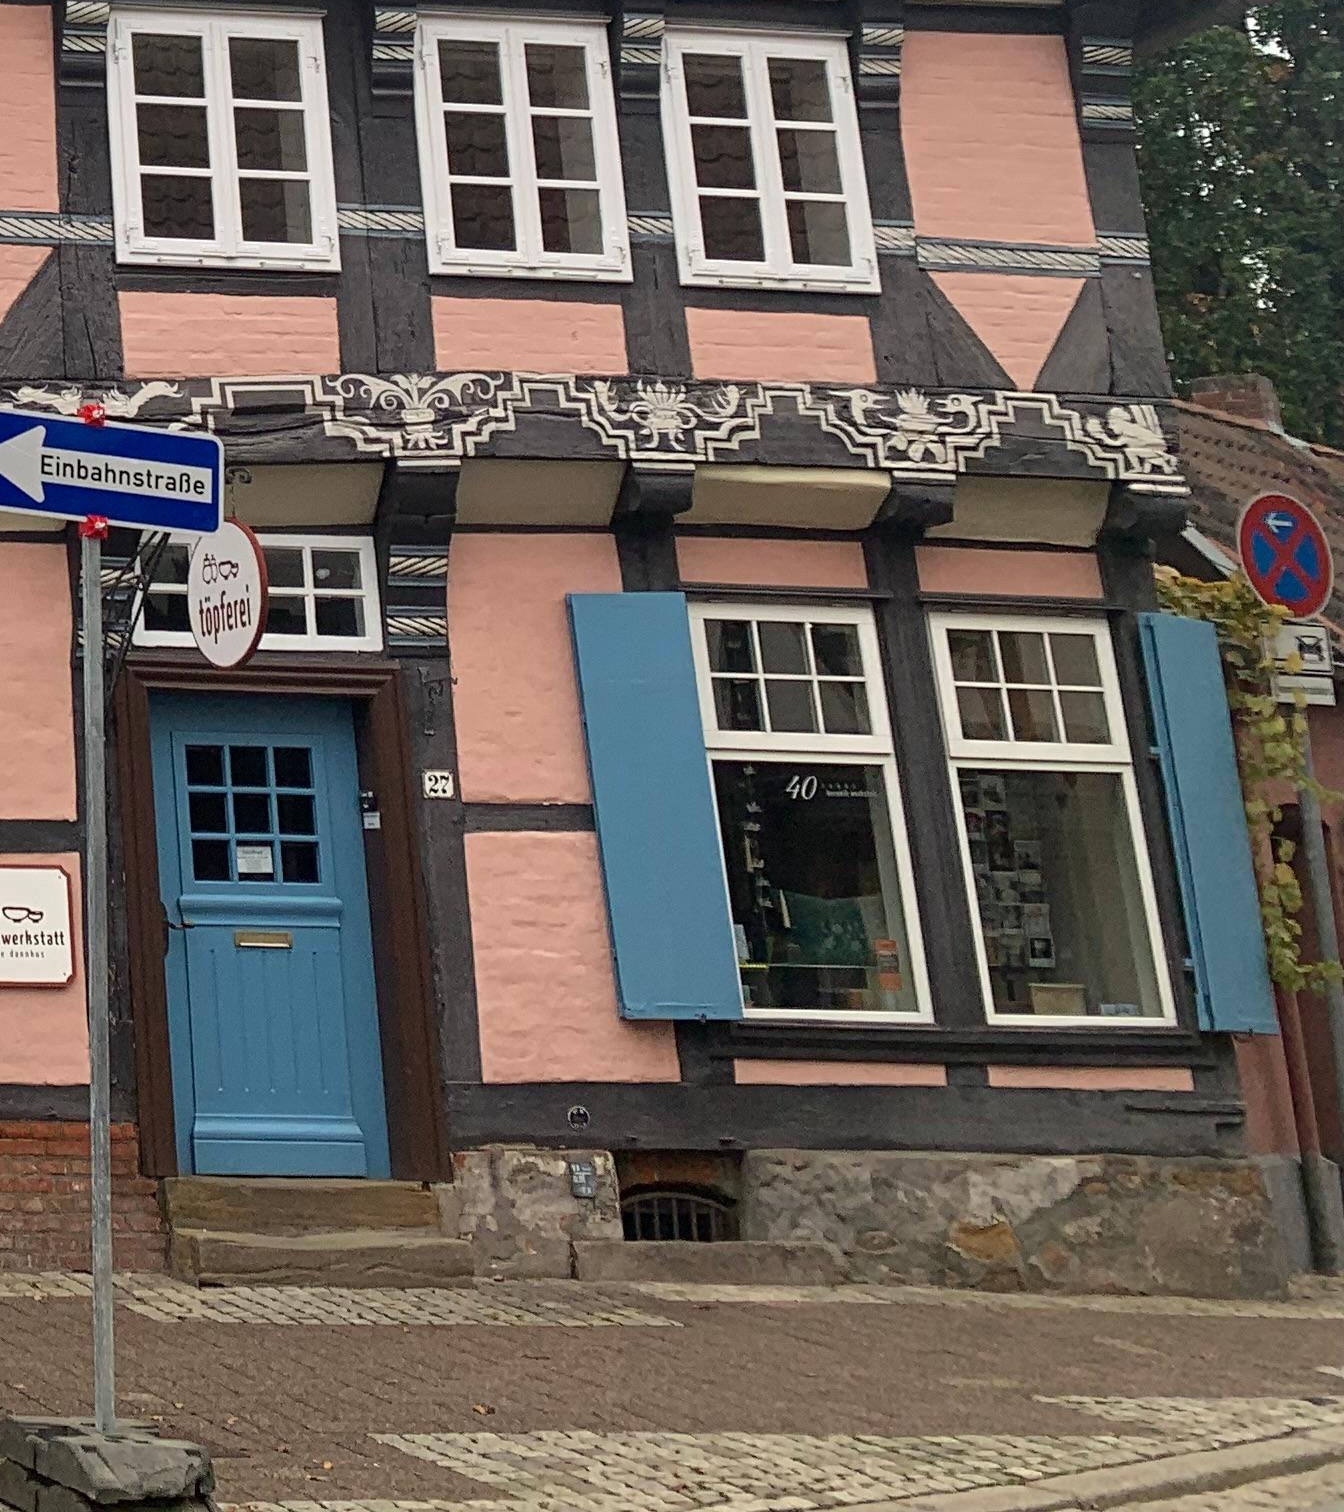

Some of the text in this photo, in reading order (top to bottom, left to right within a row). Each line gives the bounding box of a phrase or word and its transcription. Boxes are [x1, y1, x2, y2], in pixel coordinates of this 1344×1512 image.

[40, 454, 206, 495] Einbahnstraße
[198, 585, 252, 644] töpferei
[428, 774, 450, 794] 27
[784, 774, 818, 800] 40
